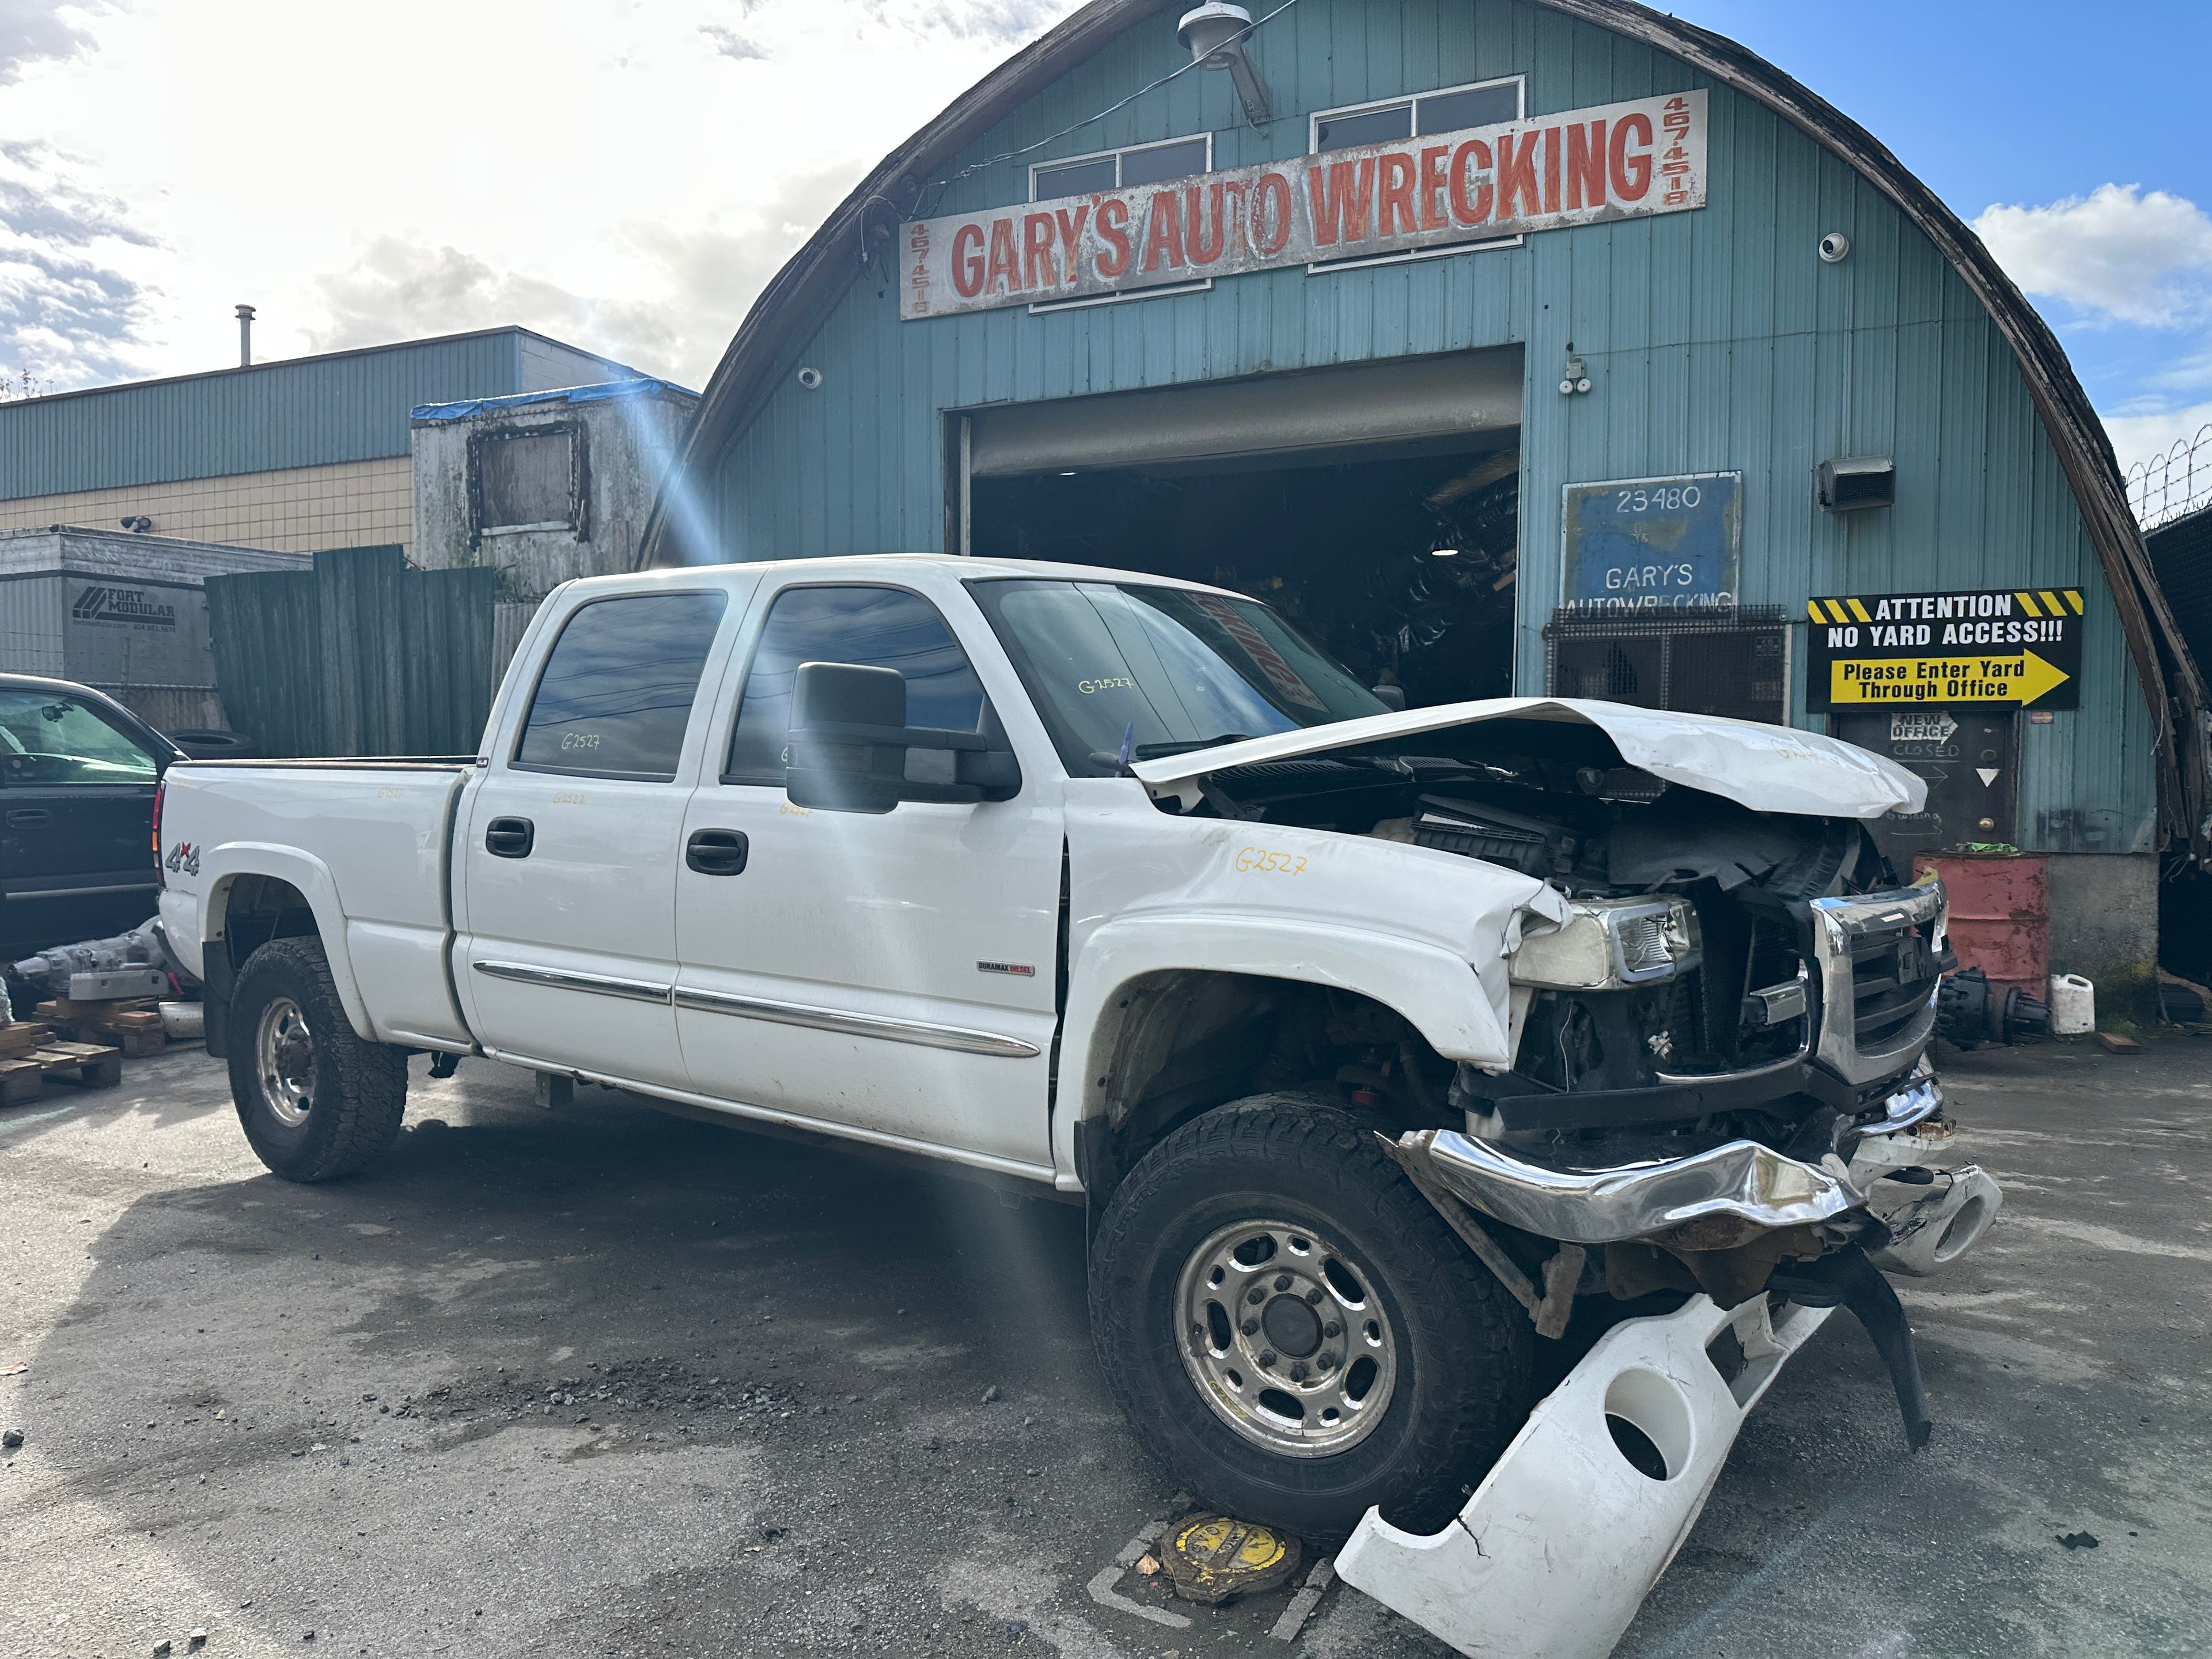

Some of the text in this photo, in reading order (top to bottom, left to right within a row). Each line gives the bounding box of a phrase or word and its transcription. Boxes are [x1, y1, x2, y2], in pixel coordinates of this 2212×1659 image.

[950, 113, 1653, 298] GARY'S AUTO WRECKING
[1616, 486, 1700, 512] 23480
[1606, 564, 1692, 589] GARY'S
[108, 589, 144, 602] FORT
[108, 600, 175, 616] MODULAR
[1876, 594, 2011, 620] ATTENTION
[1828, 620, 2063, 647] NO YARD ACCESS!!!
[1844, 660, 2024, 680] Please Enter Yard
[1078, 678, 1134, 694] G2527
[1859, 680, 2008, 699] Through Office
[1902, 714, 1941, 725] NEW
[561, 733, 600, 750] G2527
[1236, 846, 1307, 876] G2527
[979, 963, 1009, 971] DURAMAX
